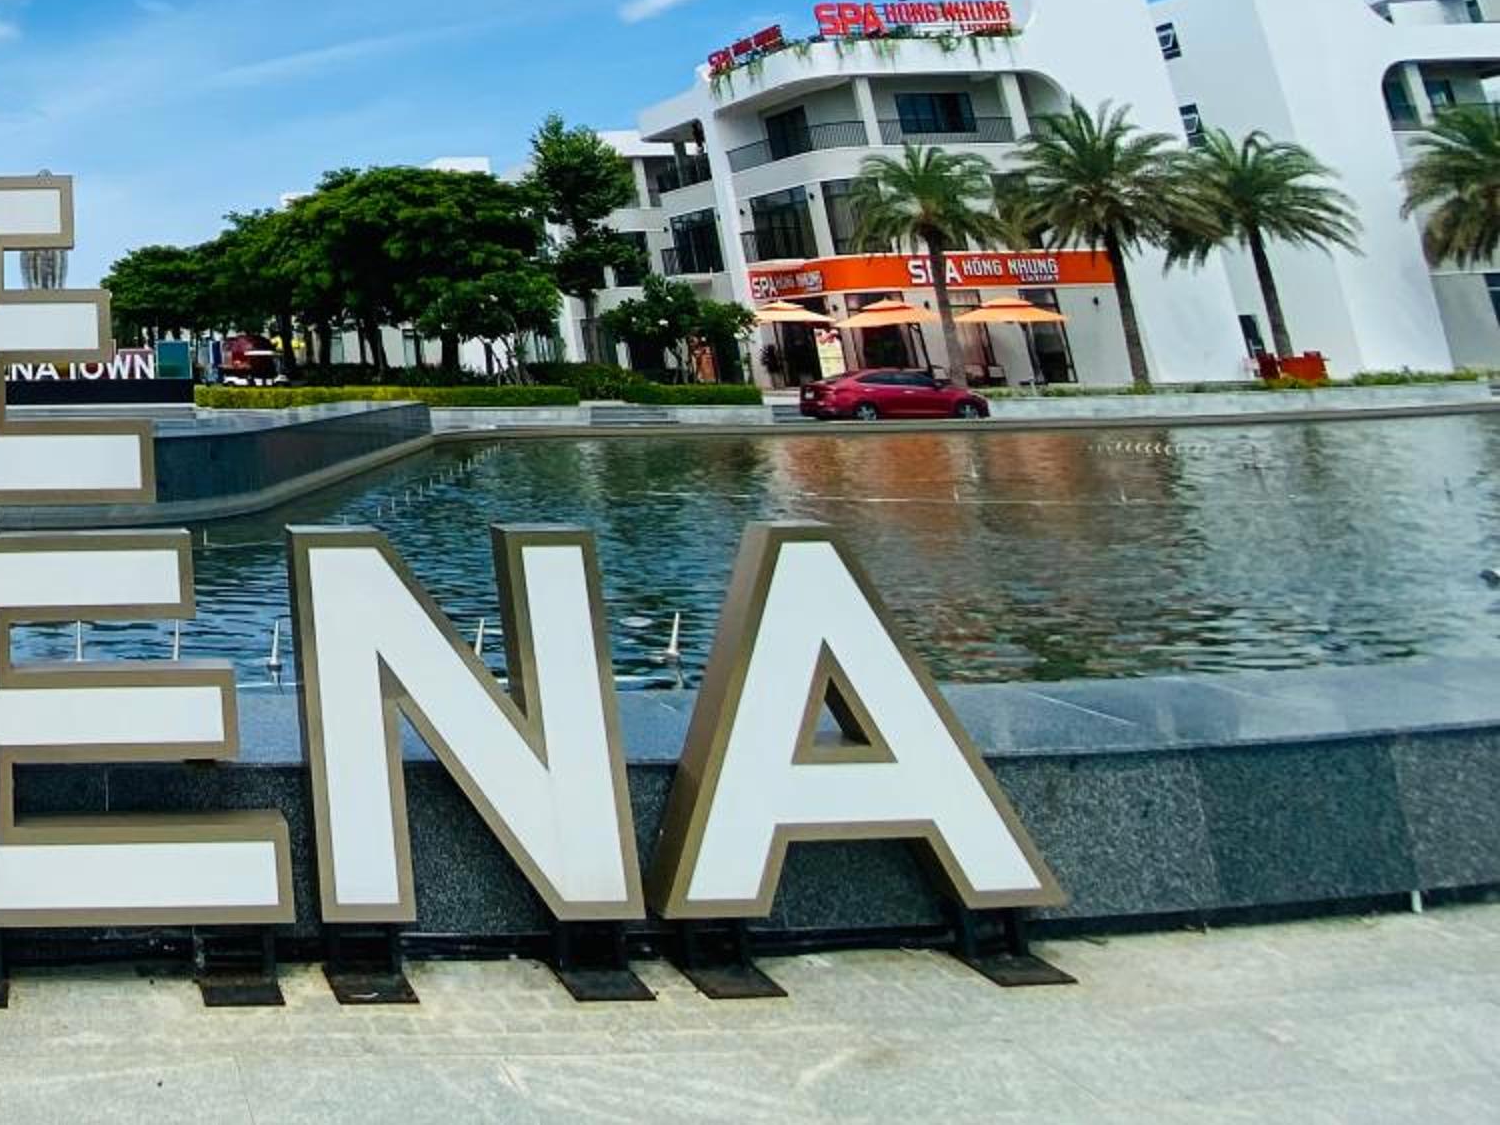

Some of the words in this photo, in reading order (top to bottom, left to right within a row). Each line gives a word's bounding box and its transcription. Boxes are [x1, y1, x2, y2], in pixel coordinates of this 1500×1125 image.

[813, 2, 886, 37] SPA
[1007, 258, 1060, 274] NHUNG
[751, 275, 779, 299] SPA
[3, 362, 60, 381] NA
